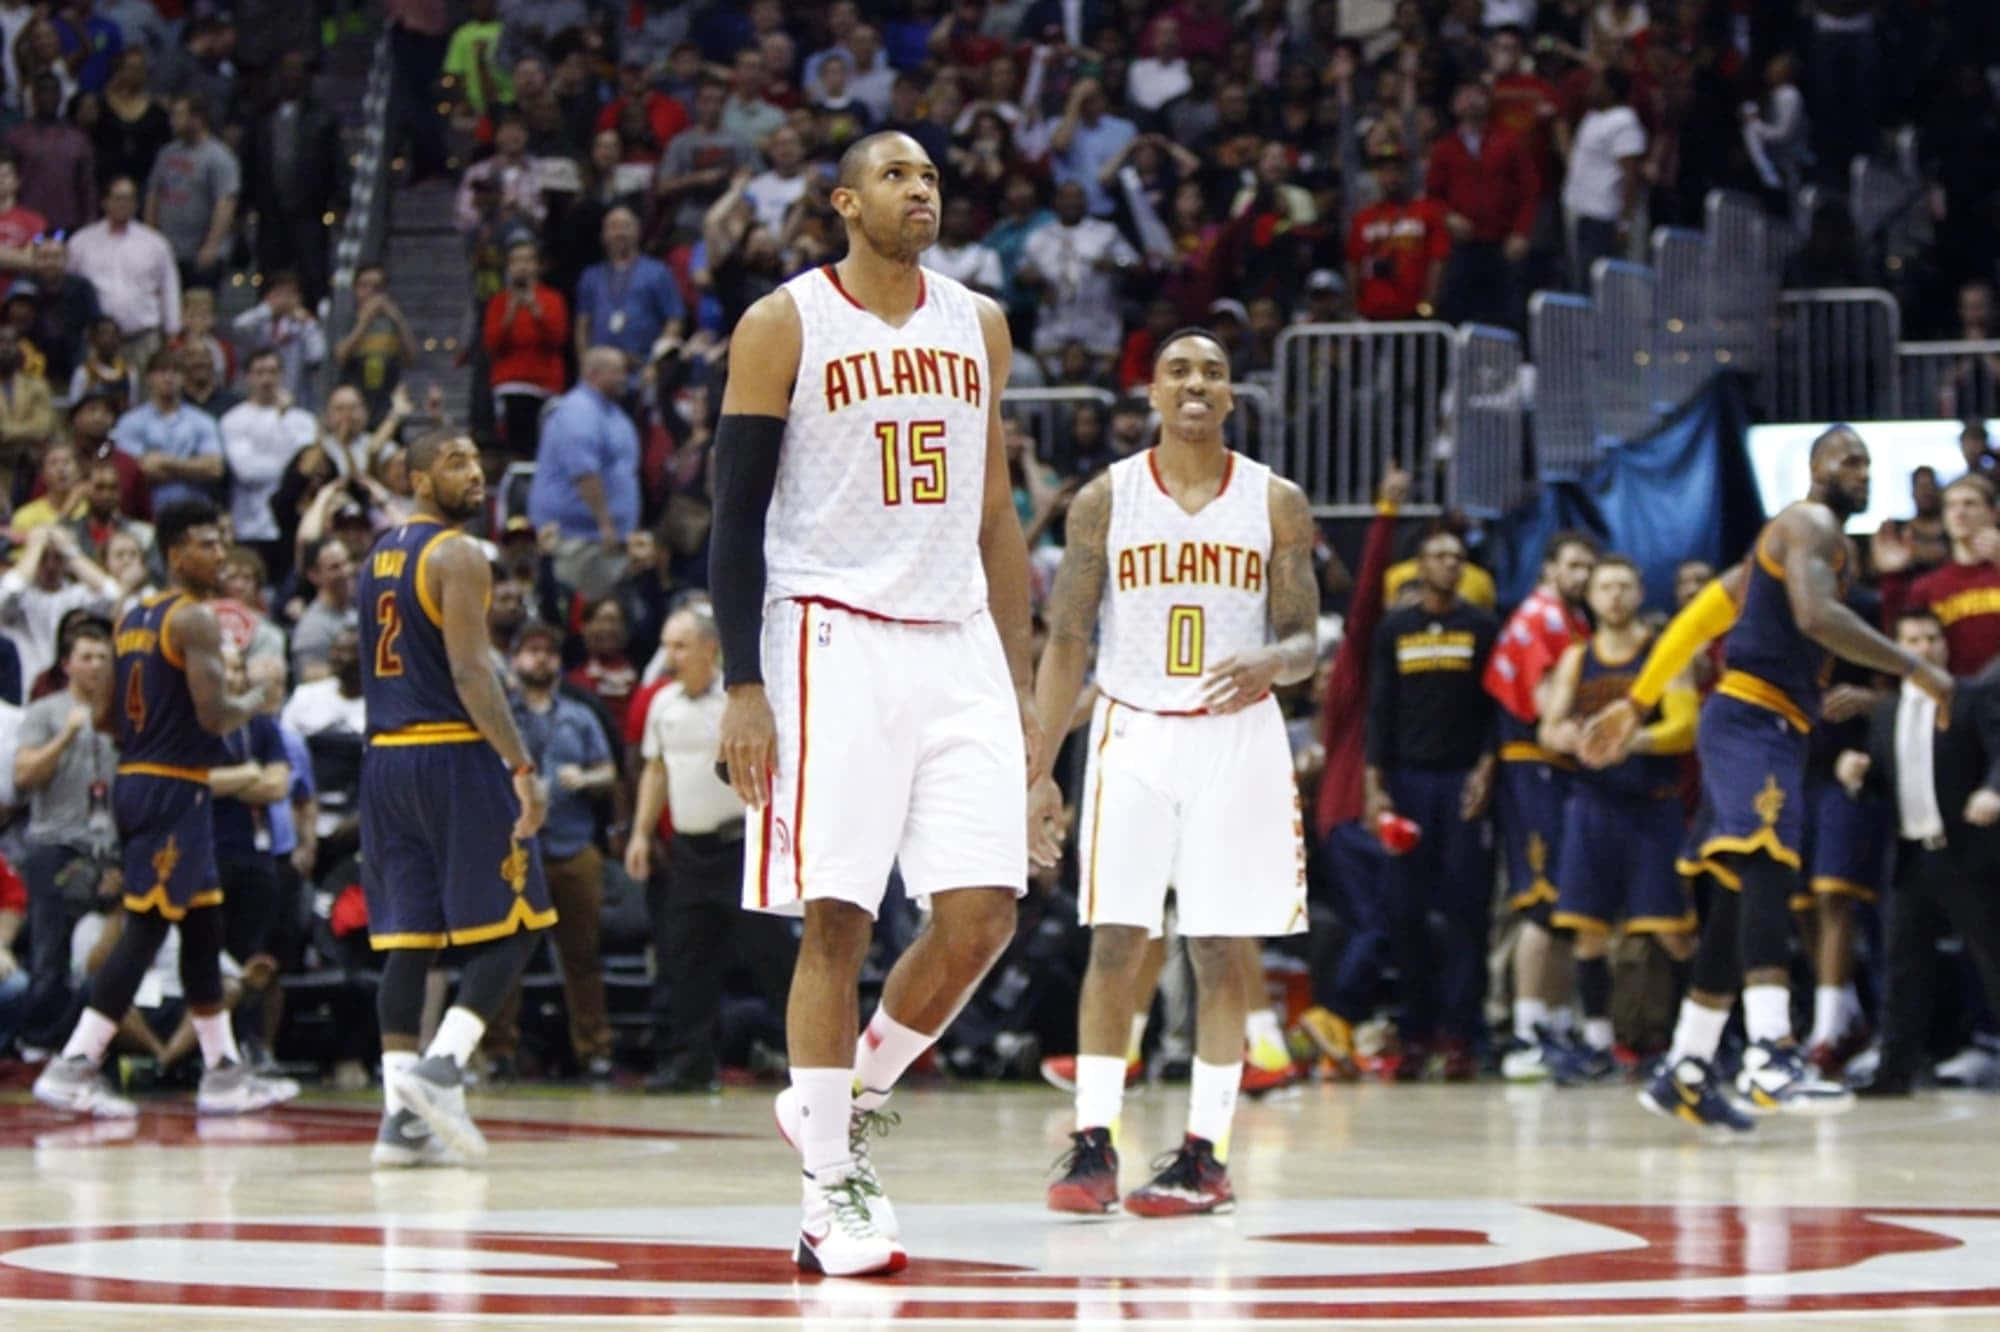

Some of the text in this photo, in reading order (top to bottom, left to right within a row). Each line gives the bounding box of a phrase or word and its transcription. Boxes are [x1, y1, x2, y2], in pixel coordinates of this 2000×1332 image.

[825, 347, 982, 413] ATLANTA
[875, 420, 947, 506] 15
[1118, 541, 1264, 593] ATLANTA
[376, 589, 404, 677] 2
[1166, 604, 1206, 677] 0
[125, 659, 148, 734] 4
